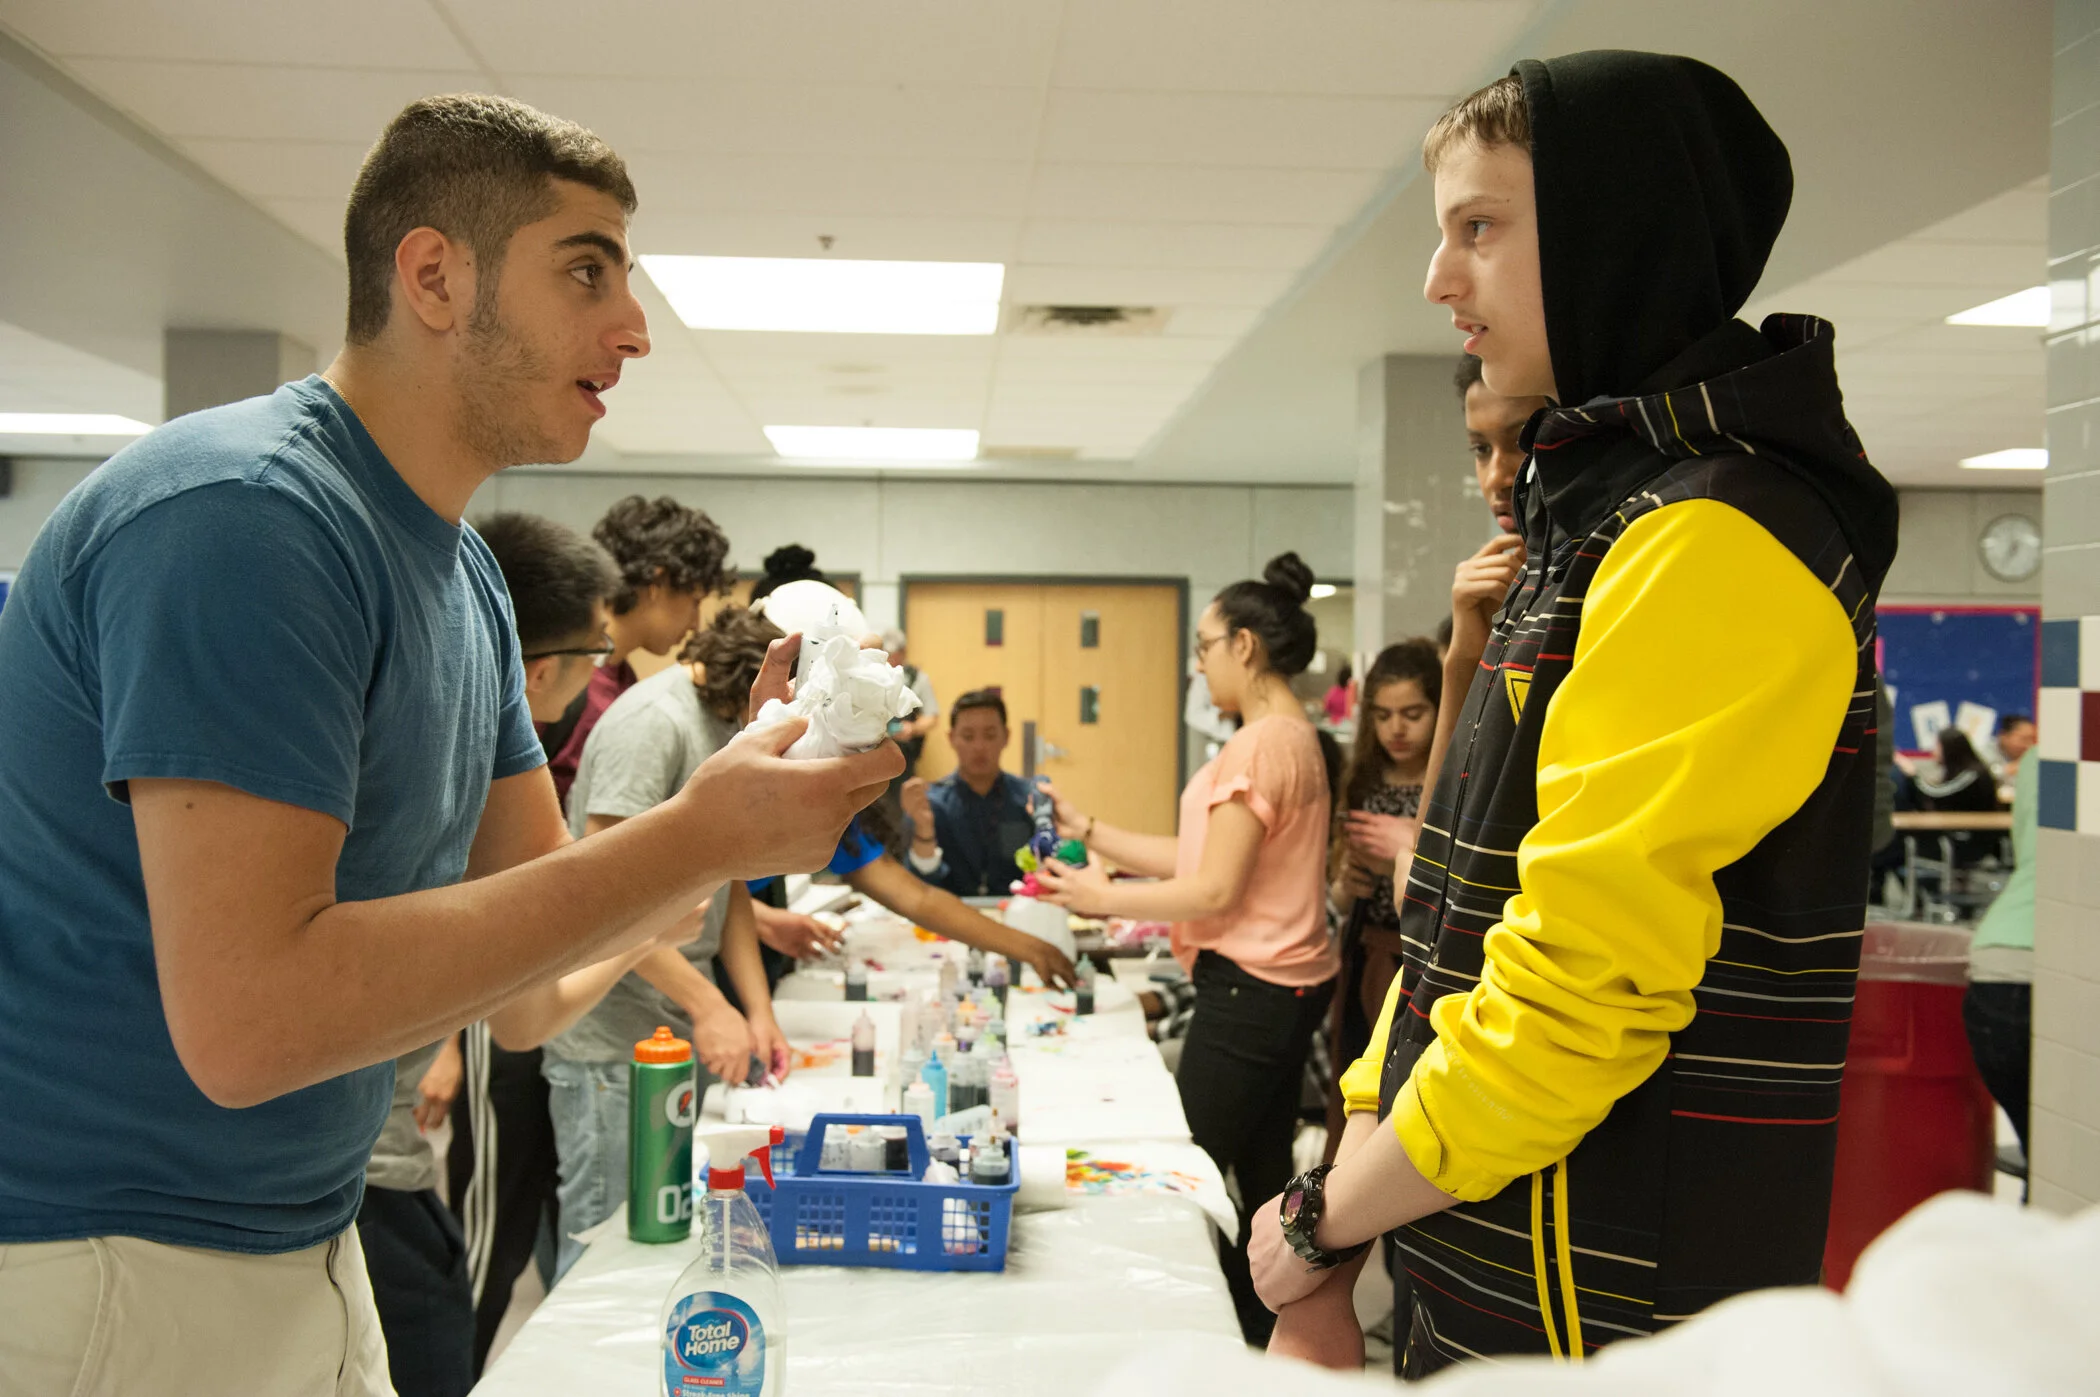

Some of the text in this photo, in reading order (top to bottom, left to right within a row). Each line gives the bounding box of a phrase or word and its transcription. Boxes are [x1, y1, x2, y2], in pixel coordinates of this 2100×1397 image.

[688, 1320, 731, 1342] Total
[684, 1336, 740, 1357] Home
[700, 1378, 723, 1386] CLEANER
